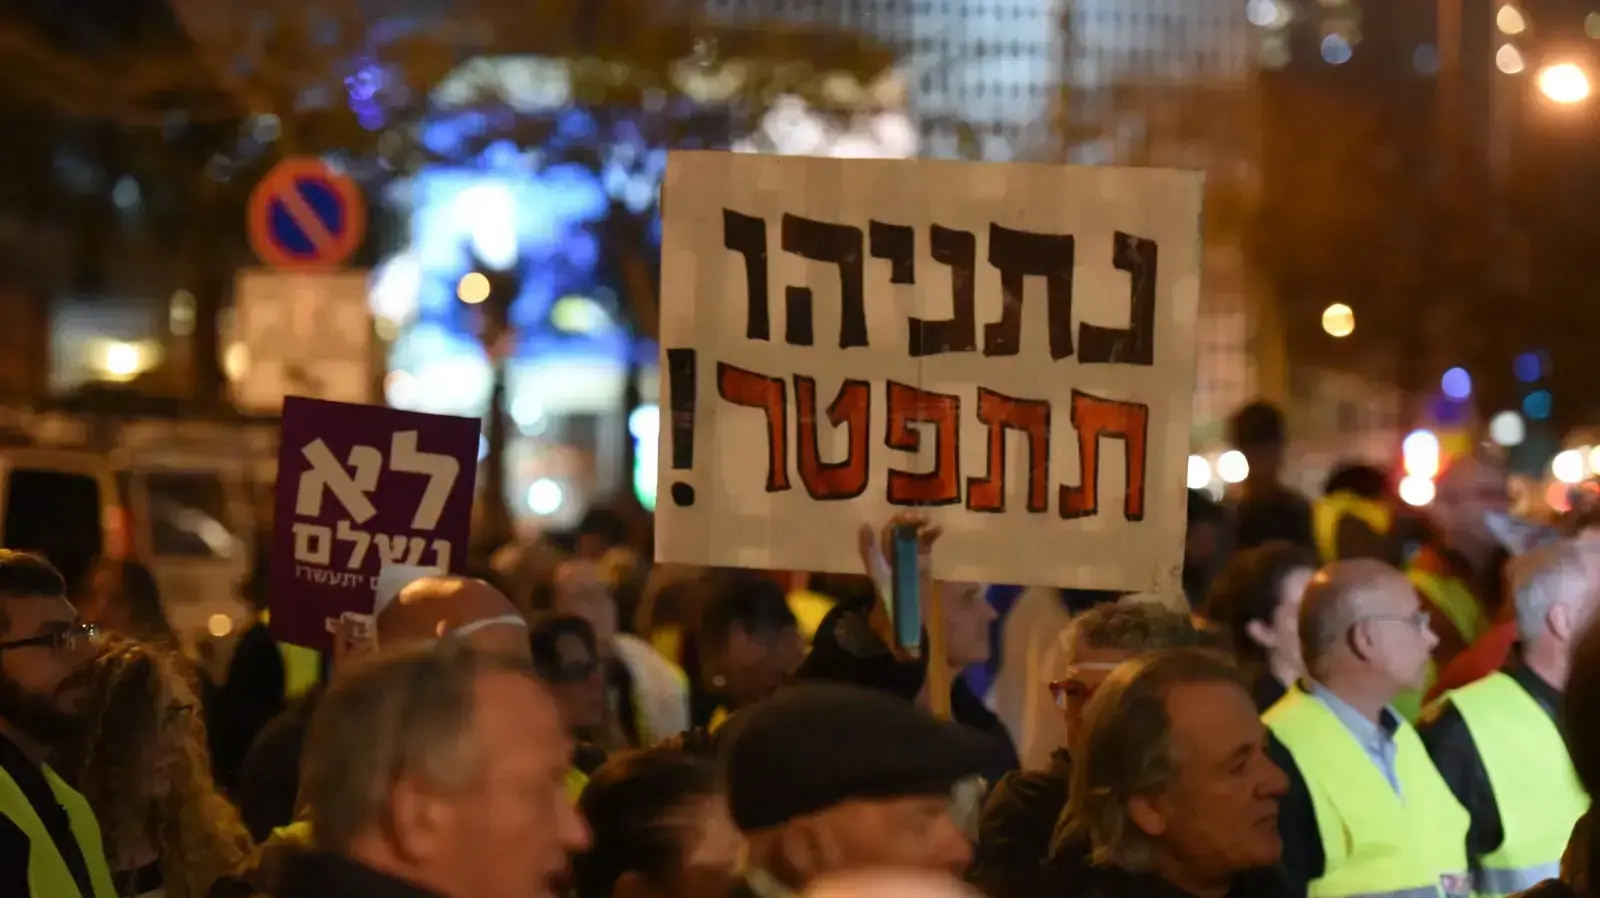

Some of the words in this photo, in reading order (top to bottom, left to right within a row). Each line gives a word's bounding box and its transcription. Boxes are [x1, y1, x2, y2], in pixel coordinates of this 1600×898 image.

[722, 208, 1158, 365] נתניהו
[295, 430, 460, 531] לא
[291, 520, 451, 575] נשלם
